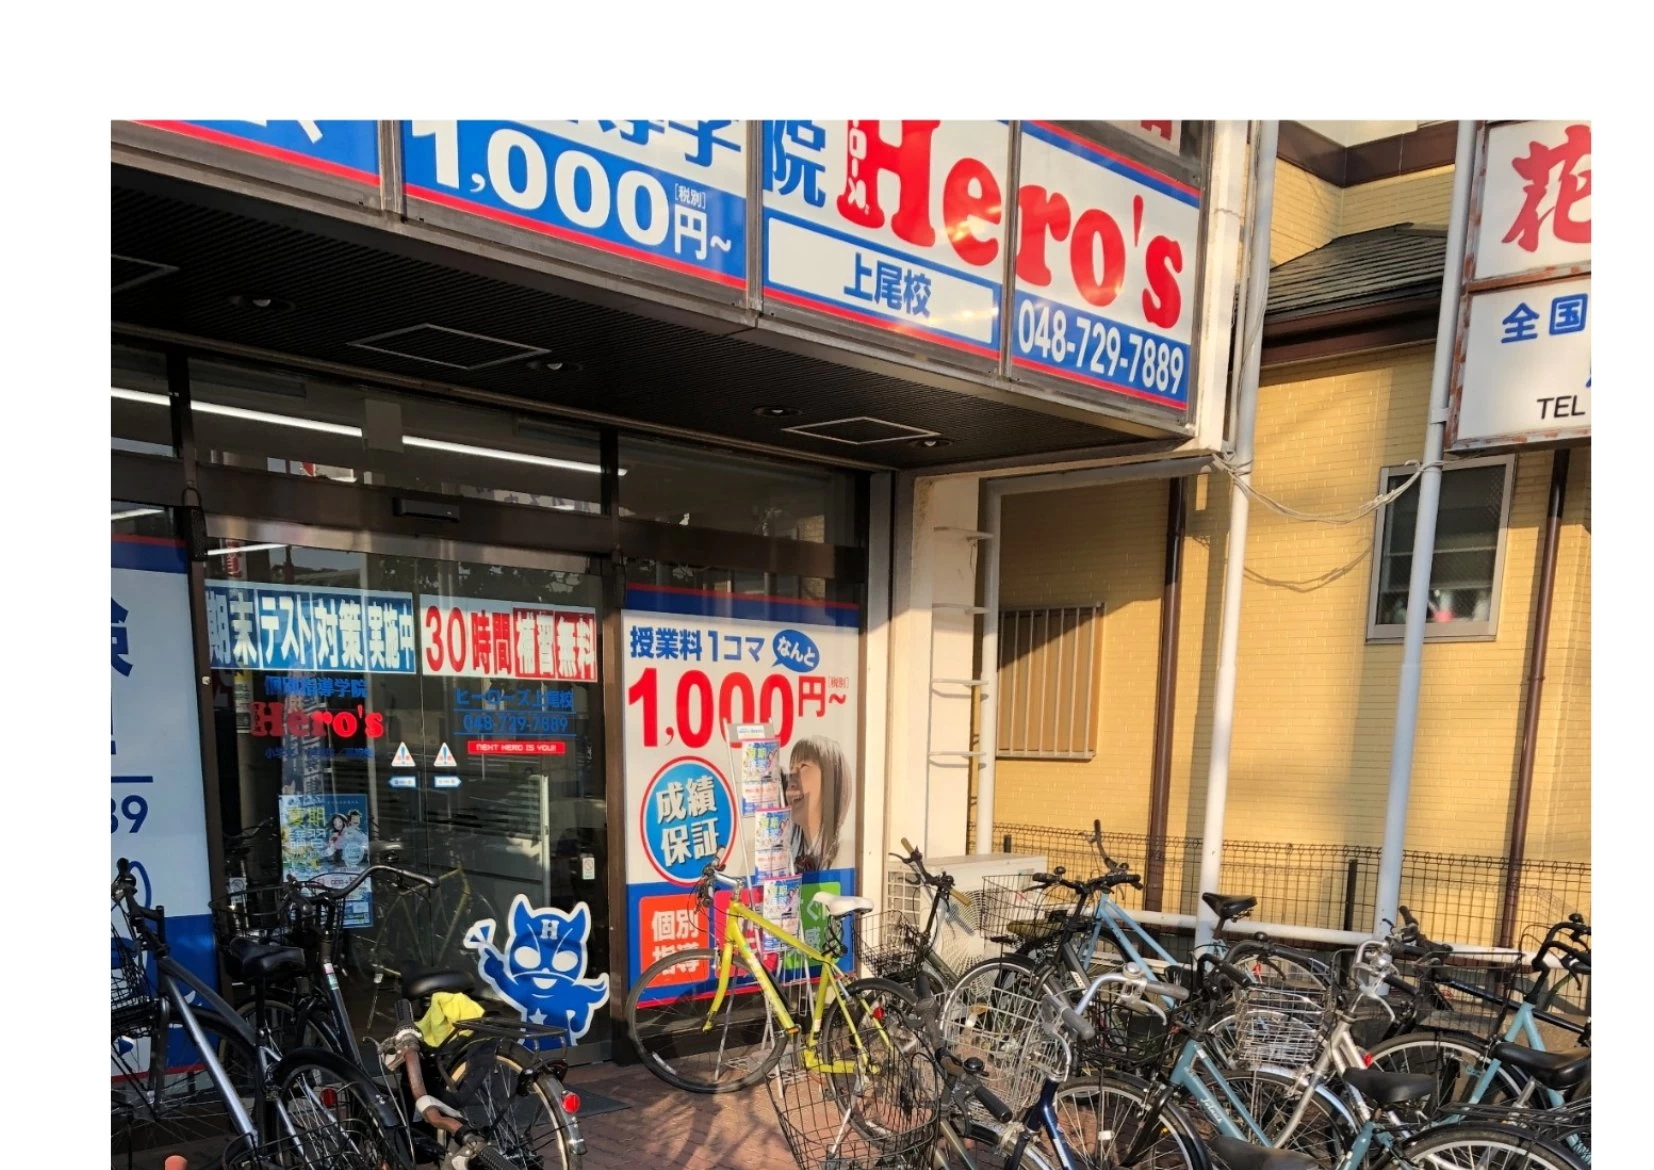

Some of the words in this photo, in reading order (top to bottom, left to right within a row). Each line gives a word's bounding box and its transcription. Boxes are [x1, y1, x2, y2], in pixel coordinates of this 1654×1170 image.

[836, 120, 1184, 328] Hero's
[843, 252, 932, 318] 上尾校
[1500, 294, 1589, 344] 全国
[1018, 299, 1184, 394] 048-729-7889
[1536, 395, 1587, 420] TEL
[206, 590, 413, 669] 期末テスト対策実施中
[425, 605, 595, 679] 30時間補習無料
[629, 625, 766, 662] 授業料1コマ
[776, 636, 816, 668] なんと
[249, 702, 385, 738] Hero's
[656, 775, 717, 824] 成績
[661, 817, 720, 867] 保証
[540, 919, 560, 940] H
[652, 910, 699, 942] 個別
